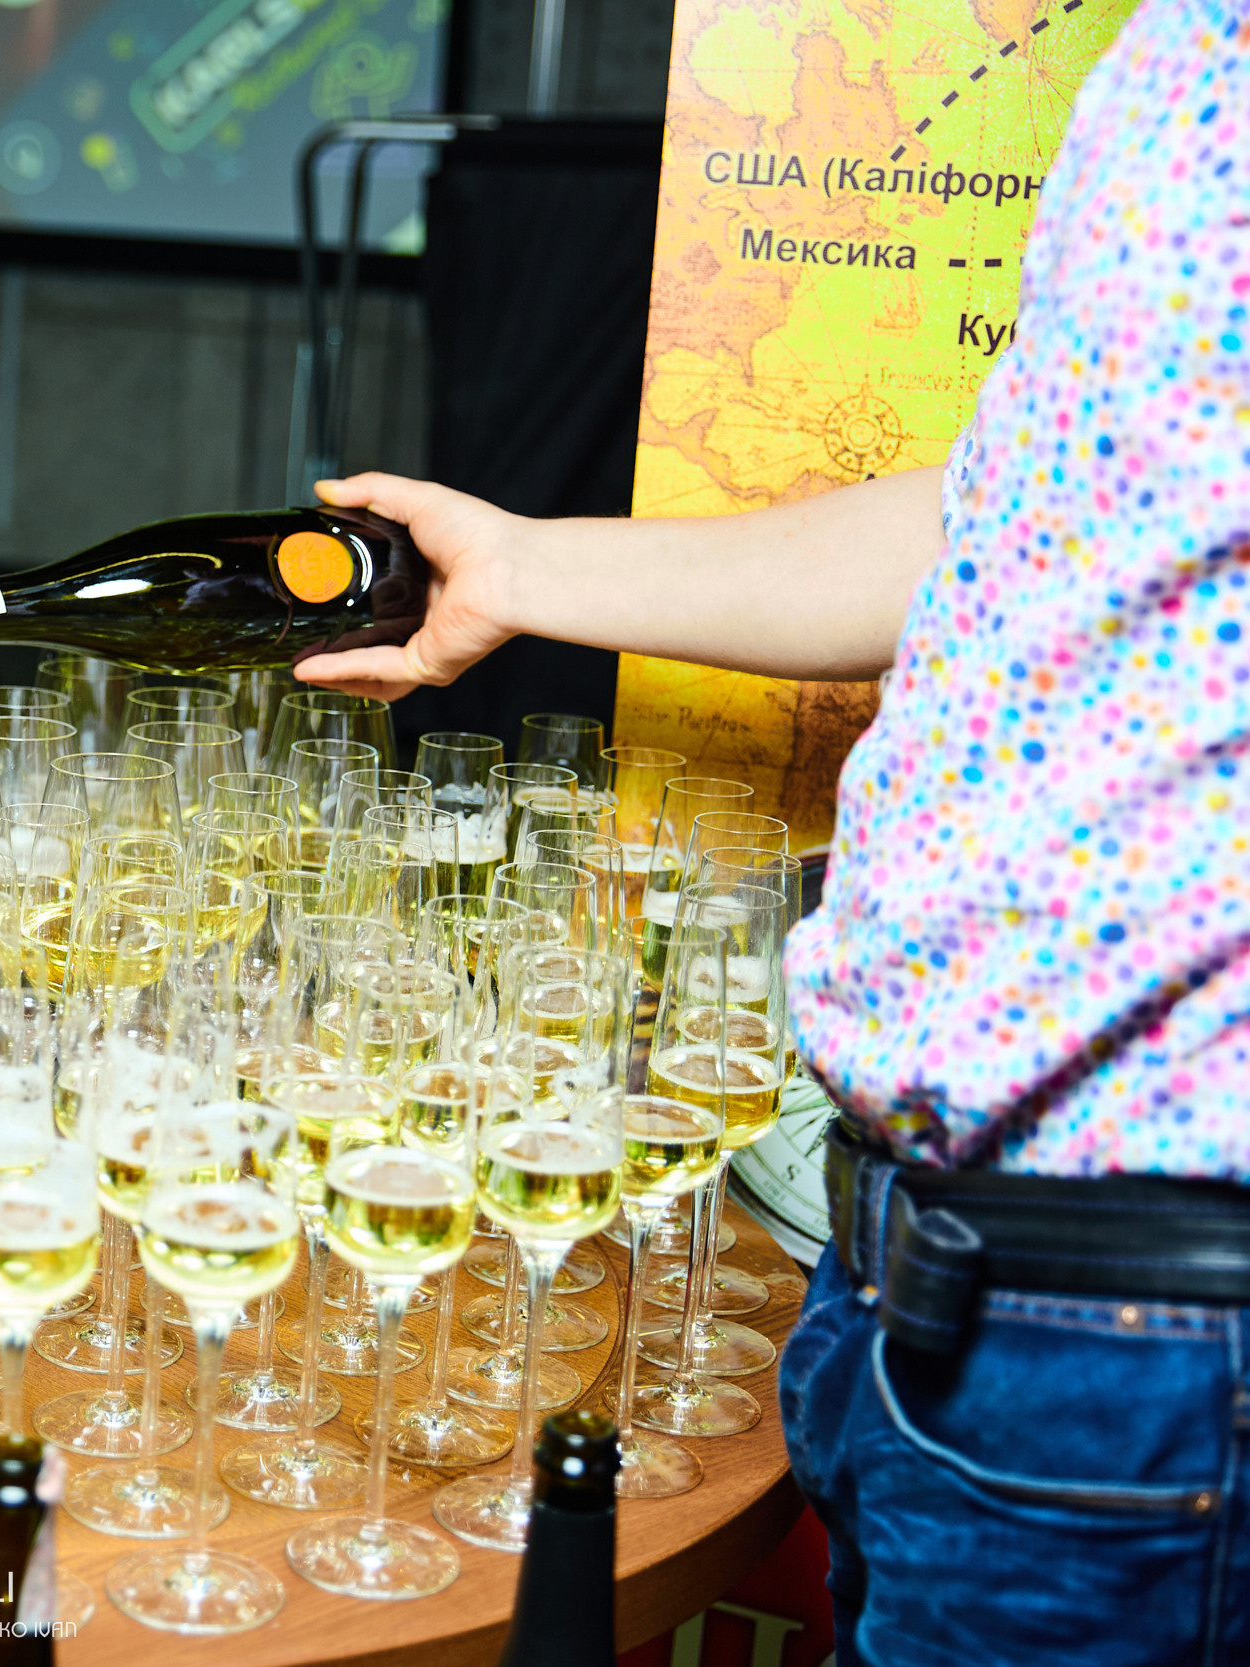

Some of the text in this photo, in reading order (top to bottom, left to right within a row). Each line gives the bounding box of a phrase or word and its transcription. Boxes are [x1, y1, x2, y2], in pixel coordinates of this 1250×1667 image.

[704, 151, 807, 188] США
[822, 156, 1046, 207] (Каліфорн
[740, 228, 916, 270] Мексика
